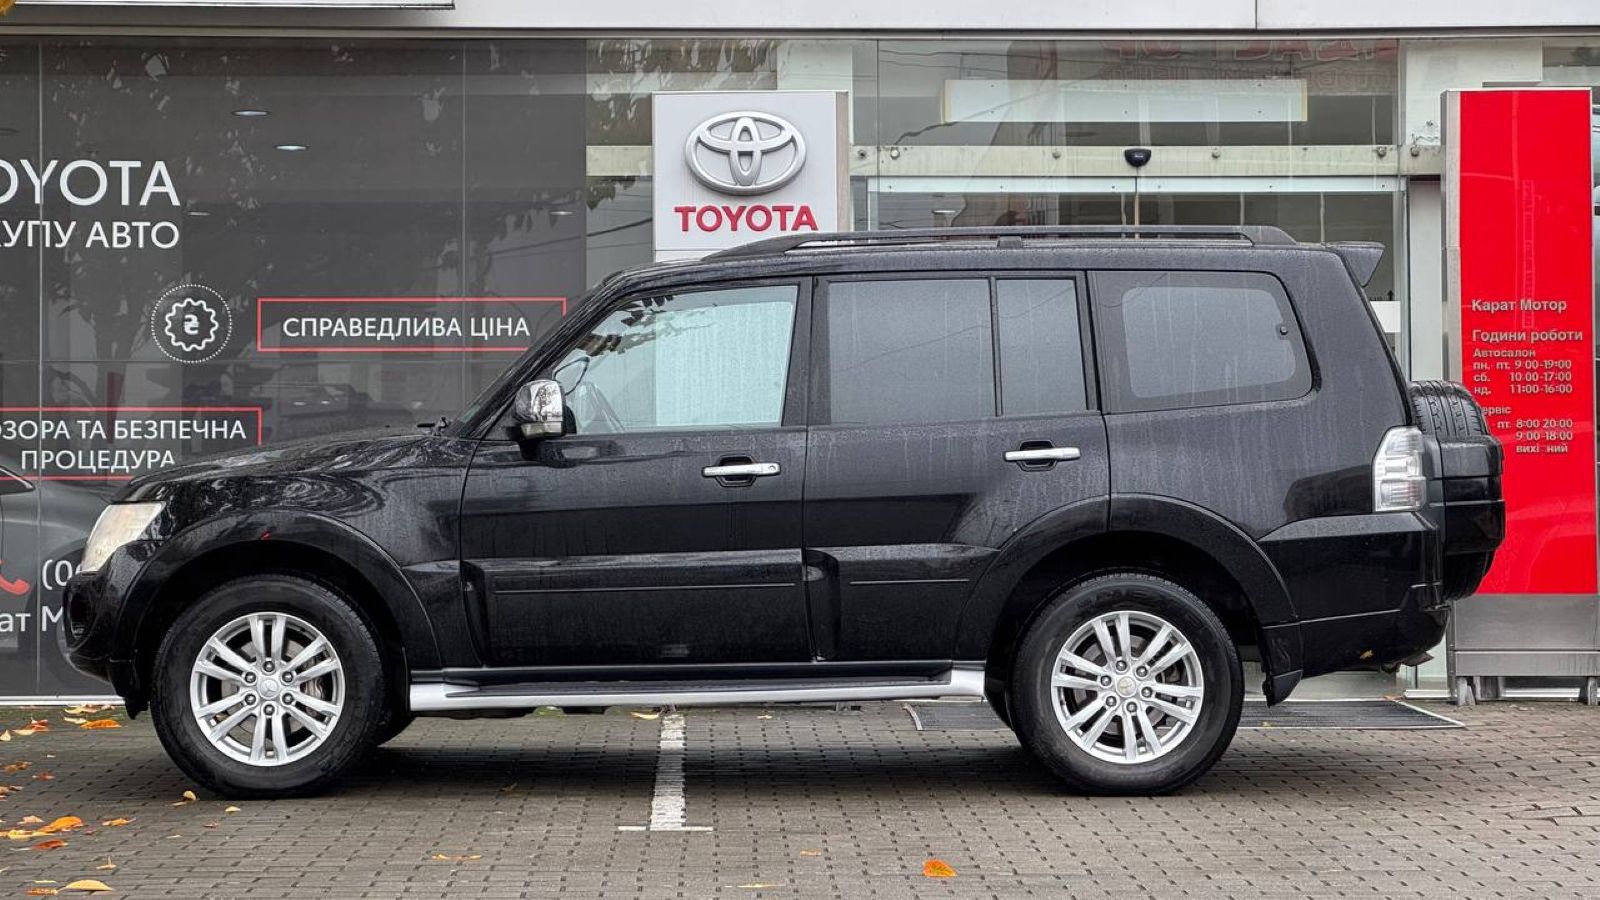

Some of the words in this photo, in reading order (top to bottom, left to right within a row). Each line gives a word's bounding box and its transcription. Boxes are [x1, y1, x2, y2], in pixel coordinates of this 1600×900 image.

[674, 205, 818, 232] TOYOTA
[0, 220, 76, 248] УПУ
[85, 220, 180, 248] АВТО
[1471, 299, 1516, 313] Карат
[1520, 299, 1567, 314] Мотор
[282, 317, 462, 341] СПРАВЕДЛИВА
[470, 317, 531, 341] ЦІНА
[1472, 329, 1526, 343] Години
[1530, 328, 1583, 343] роботи
[1473, 348, 1536, 358] Автосалон
[1480, 406, 1512, 416] ервіс
[0, 419, 71, 440] ЗОРА
[77, 420, 107, 440] ТА
[114, 419, 246, 440] БЕЗПЕЧНА
[21, 450, 176, 473] ПРОЦЕДУРА
